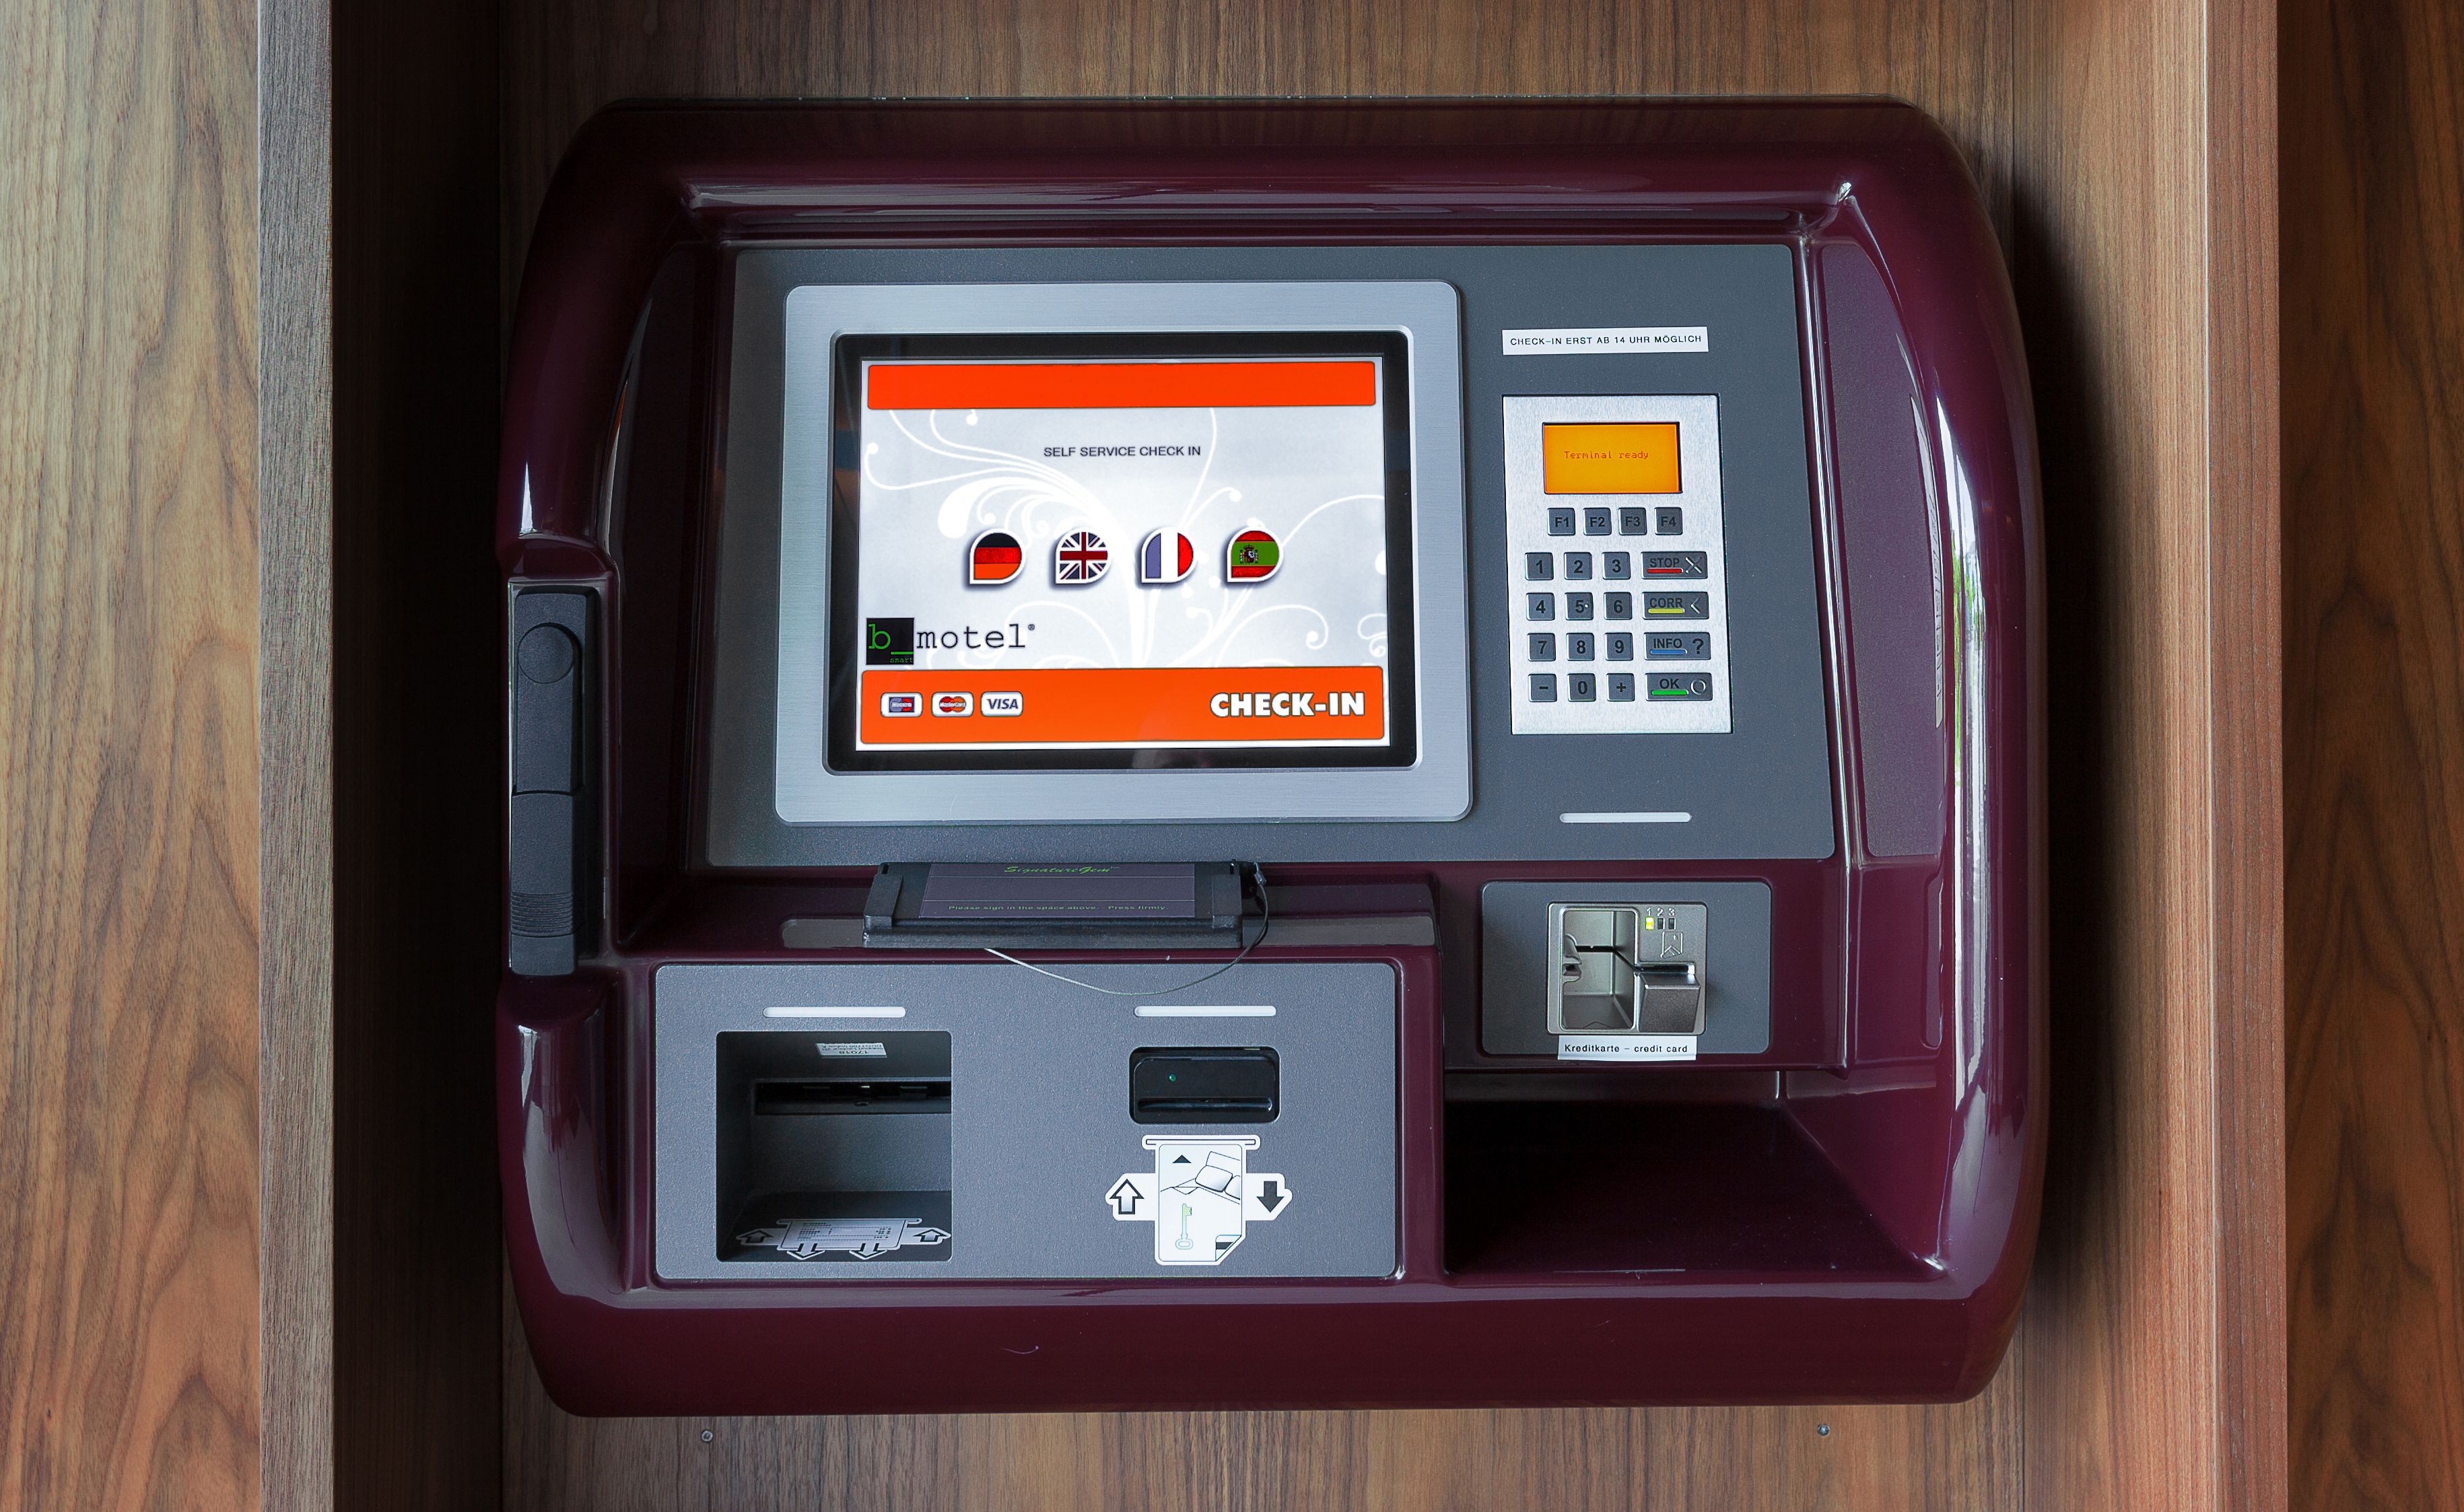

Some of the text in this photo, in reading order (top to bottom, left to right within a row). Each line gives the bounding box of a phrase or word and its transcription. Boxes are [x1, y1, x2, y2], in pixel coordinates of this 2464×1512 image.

[1654, 335, 1701, 343] MÖGLICH
[1043, 446, 1201, 457] SELF SERVICE CHECK IN
[1564, 450, 1649, 460] Terminal ready
[1554, 516, 1569, 528] F1
[1589, 516, 1605, 528] F2
[1624, 516, 1641, 527] F3
[1660, 516, 1676, 527] F4
[1536, 560, 1543, 574] 1
[1573, 559, 1583, 574] 2
[1612, 559, 1622, 573] 3
[1649, 557, 1680, 568] STOP
[1536, 600, 1546, 614] 4
[1575, 600, 1585, 613] 5
[1613, 600, 1623, 613] 6
[1649, 597, 1683, 609] CORR
[1538, 640, 1547, 654] 7
[1576, 640, 1586, 654] 8
[1614, 640, 1624, 653] 9
[1653, 638, 1682, 649] INFO
[1577, 681, 1587, 695] 0
[1659, 678, 1680, 689] OK
[986, 698, 1019, 710] VISA
[1210, 691, 1365, 718] CHECK-IN
[1646, 907, 1675, 916] 1 2 3
[1565, 1044, 1620, 1052] Kreditkarte
[1666, 1045, 1688, 1053] card
